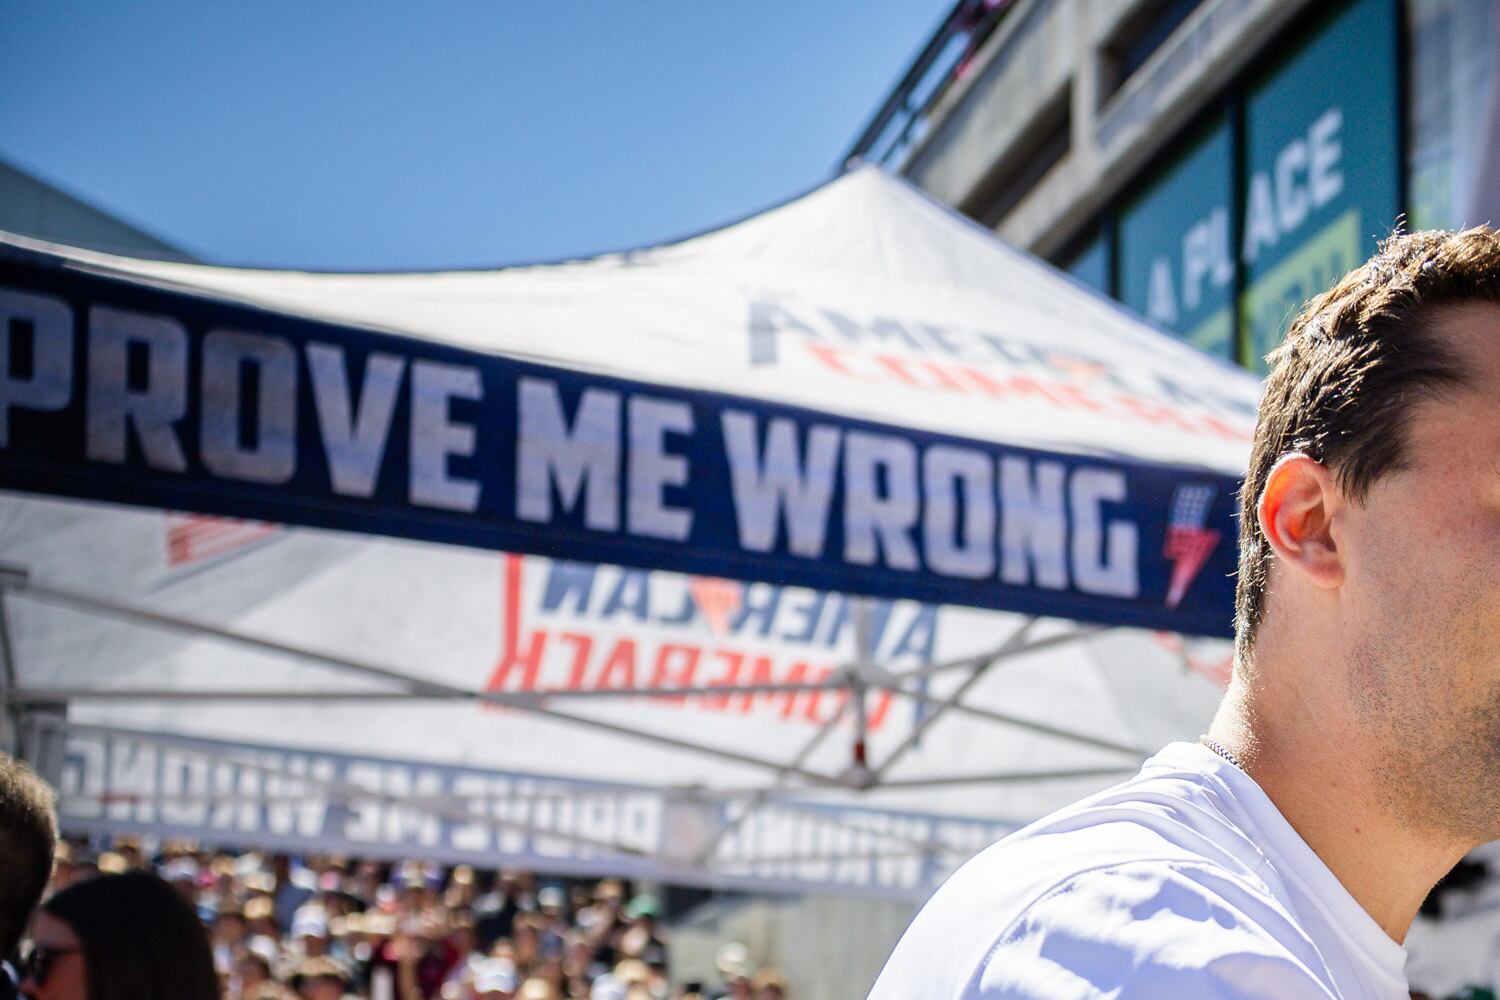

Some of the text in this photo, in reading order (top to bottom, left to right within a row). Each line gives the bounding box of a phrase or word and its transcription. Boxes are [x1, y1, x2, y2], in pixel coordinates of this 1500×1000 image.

[1182, 106, 1345, 312] PLACE
[0, 289, 1141, 600] PROVE ME WRONG
